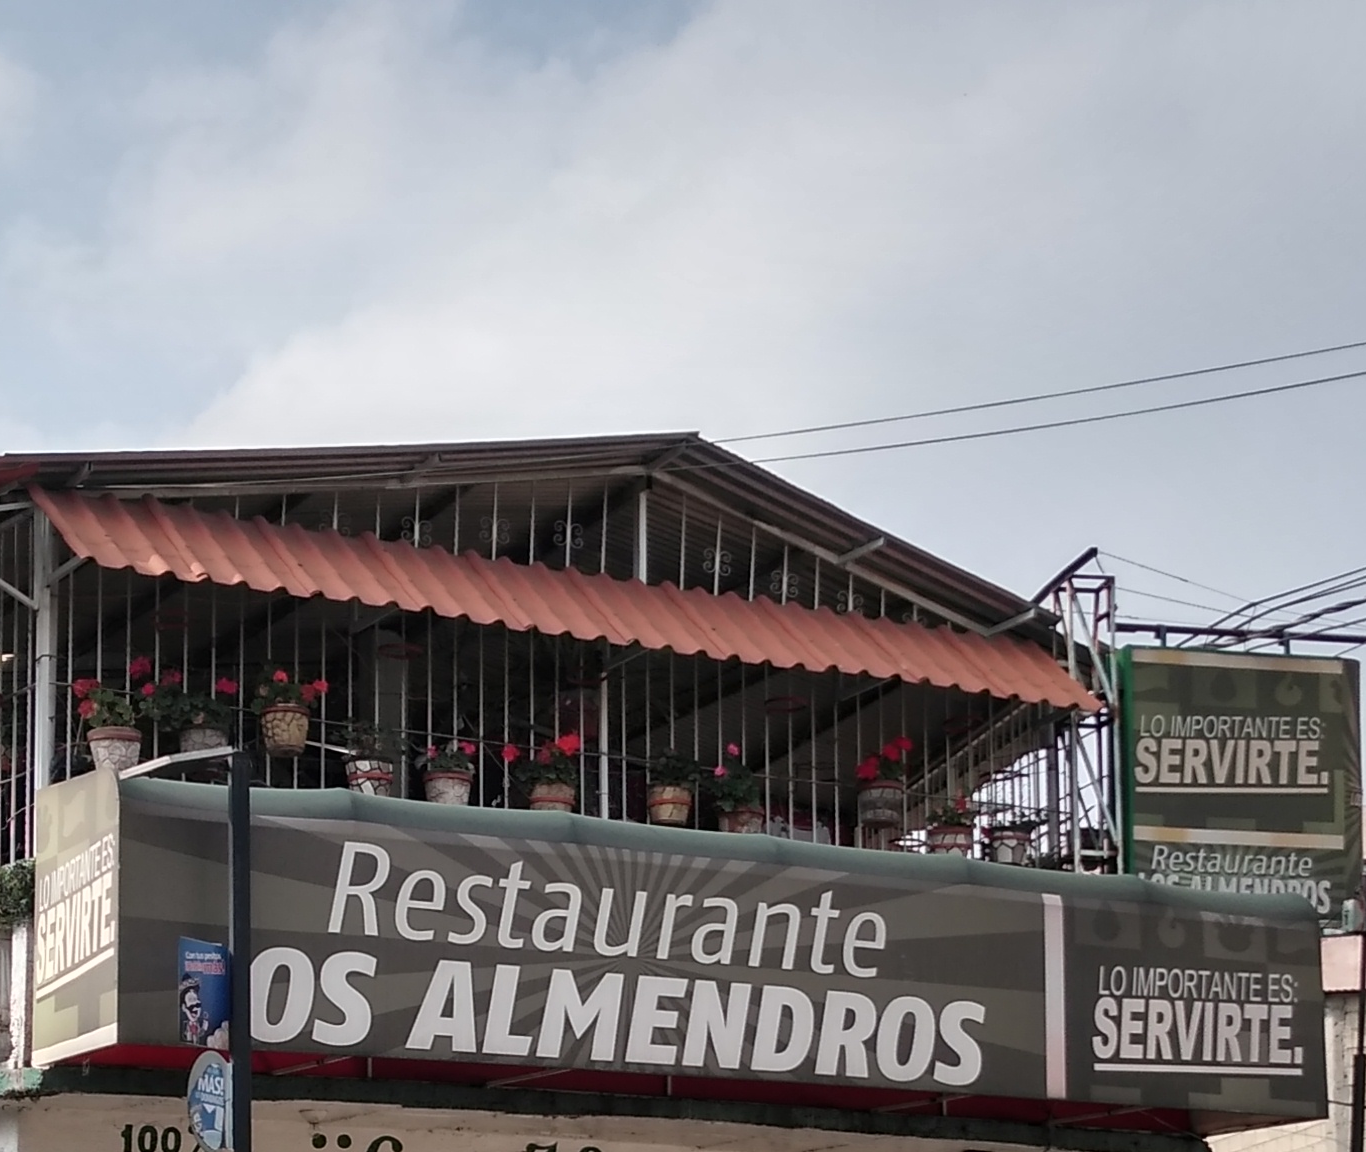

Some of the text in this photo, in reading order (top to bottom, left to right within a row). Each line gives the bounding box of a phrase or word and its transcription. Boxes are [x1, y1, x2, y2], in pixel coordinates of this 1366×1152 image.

[1135, 738, 1329, 785] SERVIRTE.
[1140, 715, 1327, 740] LO IMPORTANTE ES:
[39, 875, 51, 912] LO
[51, 840, 102, 906] IMPORTANTE
[1151, 845, 1313, 877] Restaurante
[36, 870, 116, 985] SERVIRTE.
[327, 840, 887, 978] Restaurante
[250, 946, 986, 1086] OS ALMENDROS
[1098, 965, 1299, 1003] LO IMPORTANTE ES:
[1092, 996, 1304, 1065] SERVIRTE.
